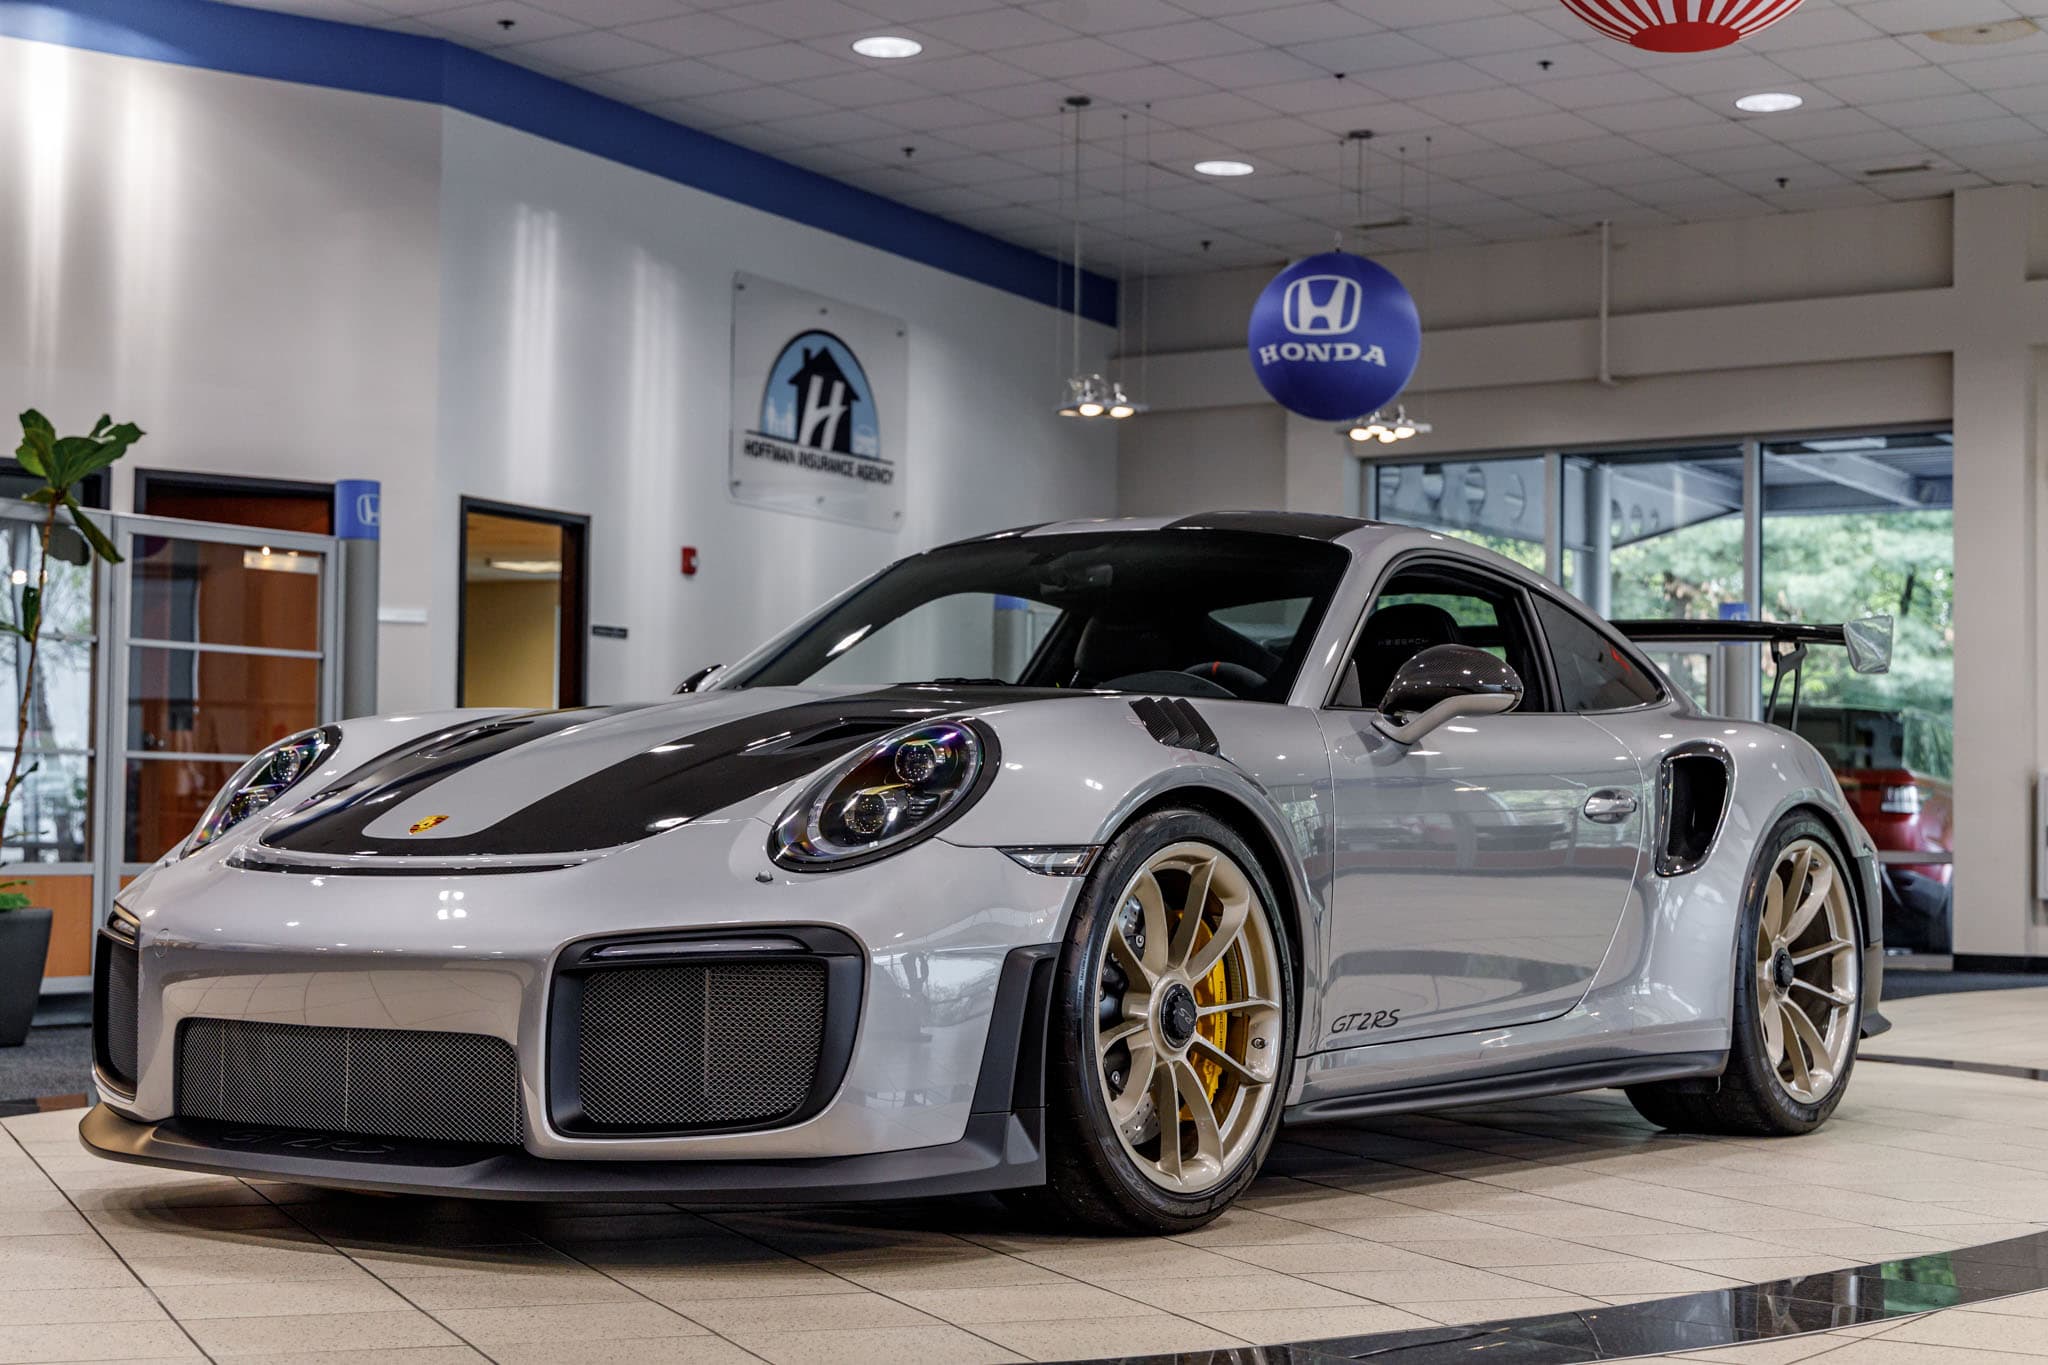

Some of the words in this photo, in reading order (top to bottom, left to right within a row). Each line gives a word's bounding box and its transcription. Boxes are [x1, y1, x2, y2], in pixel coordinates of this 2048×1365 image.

[1258, 342, 1387, 367] HONDA
[744, 439, 796, 463] HOFFMAN
[798, 451, 855, 476] INSURANCE
[856, 463, 895, 484] AGENCY
[1331, 1009, 1401, 1033] GT2RS
